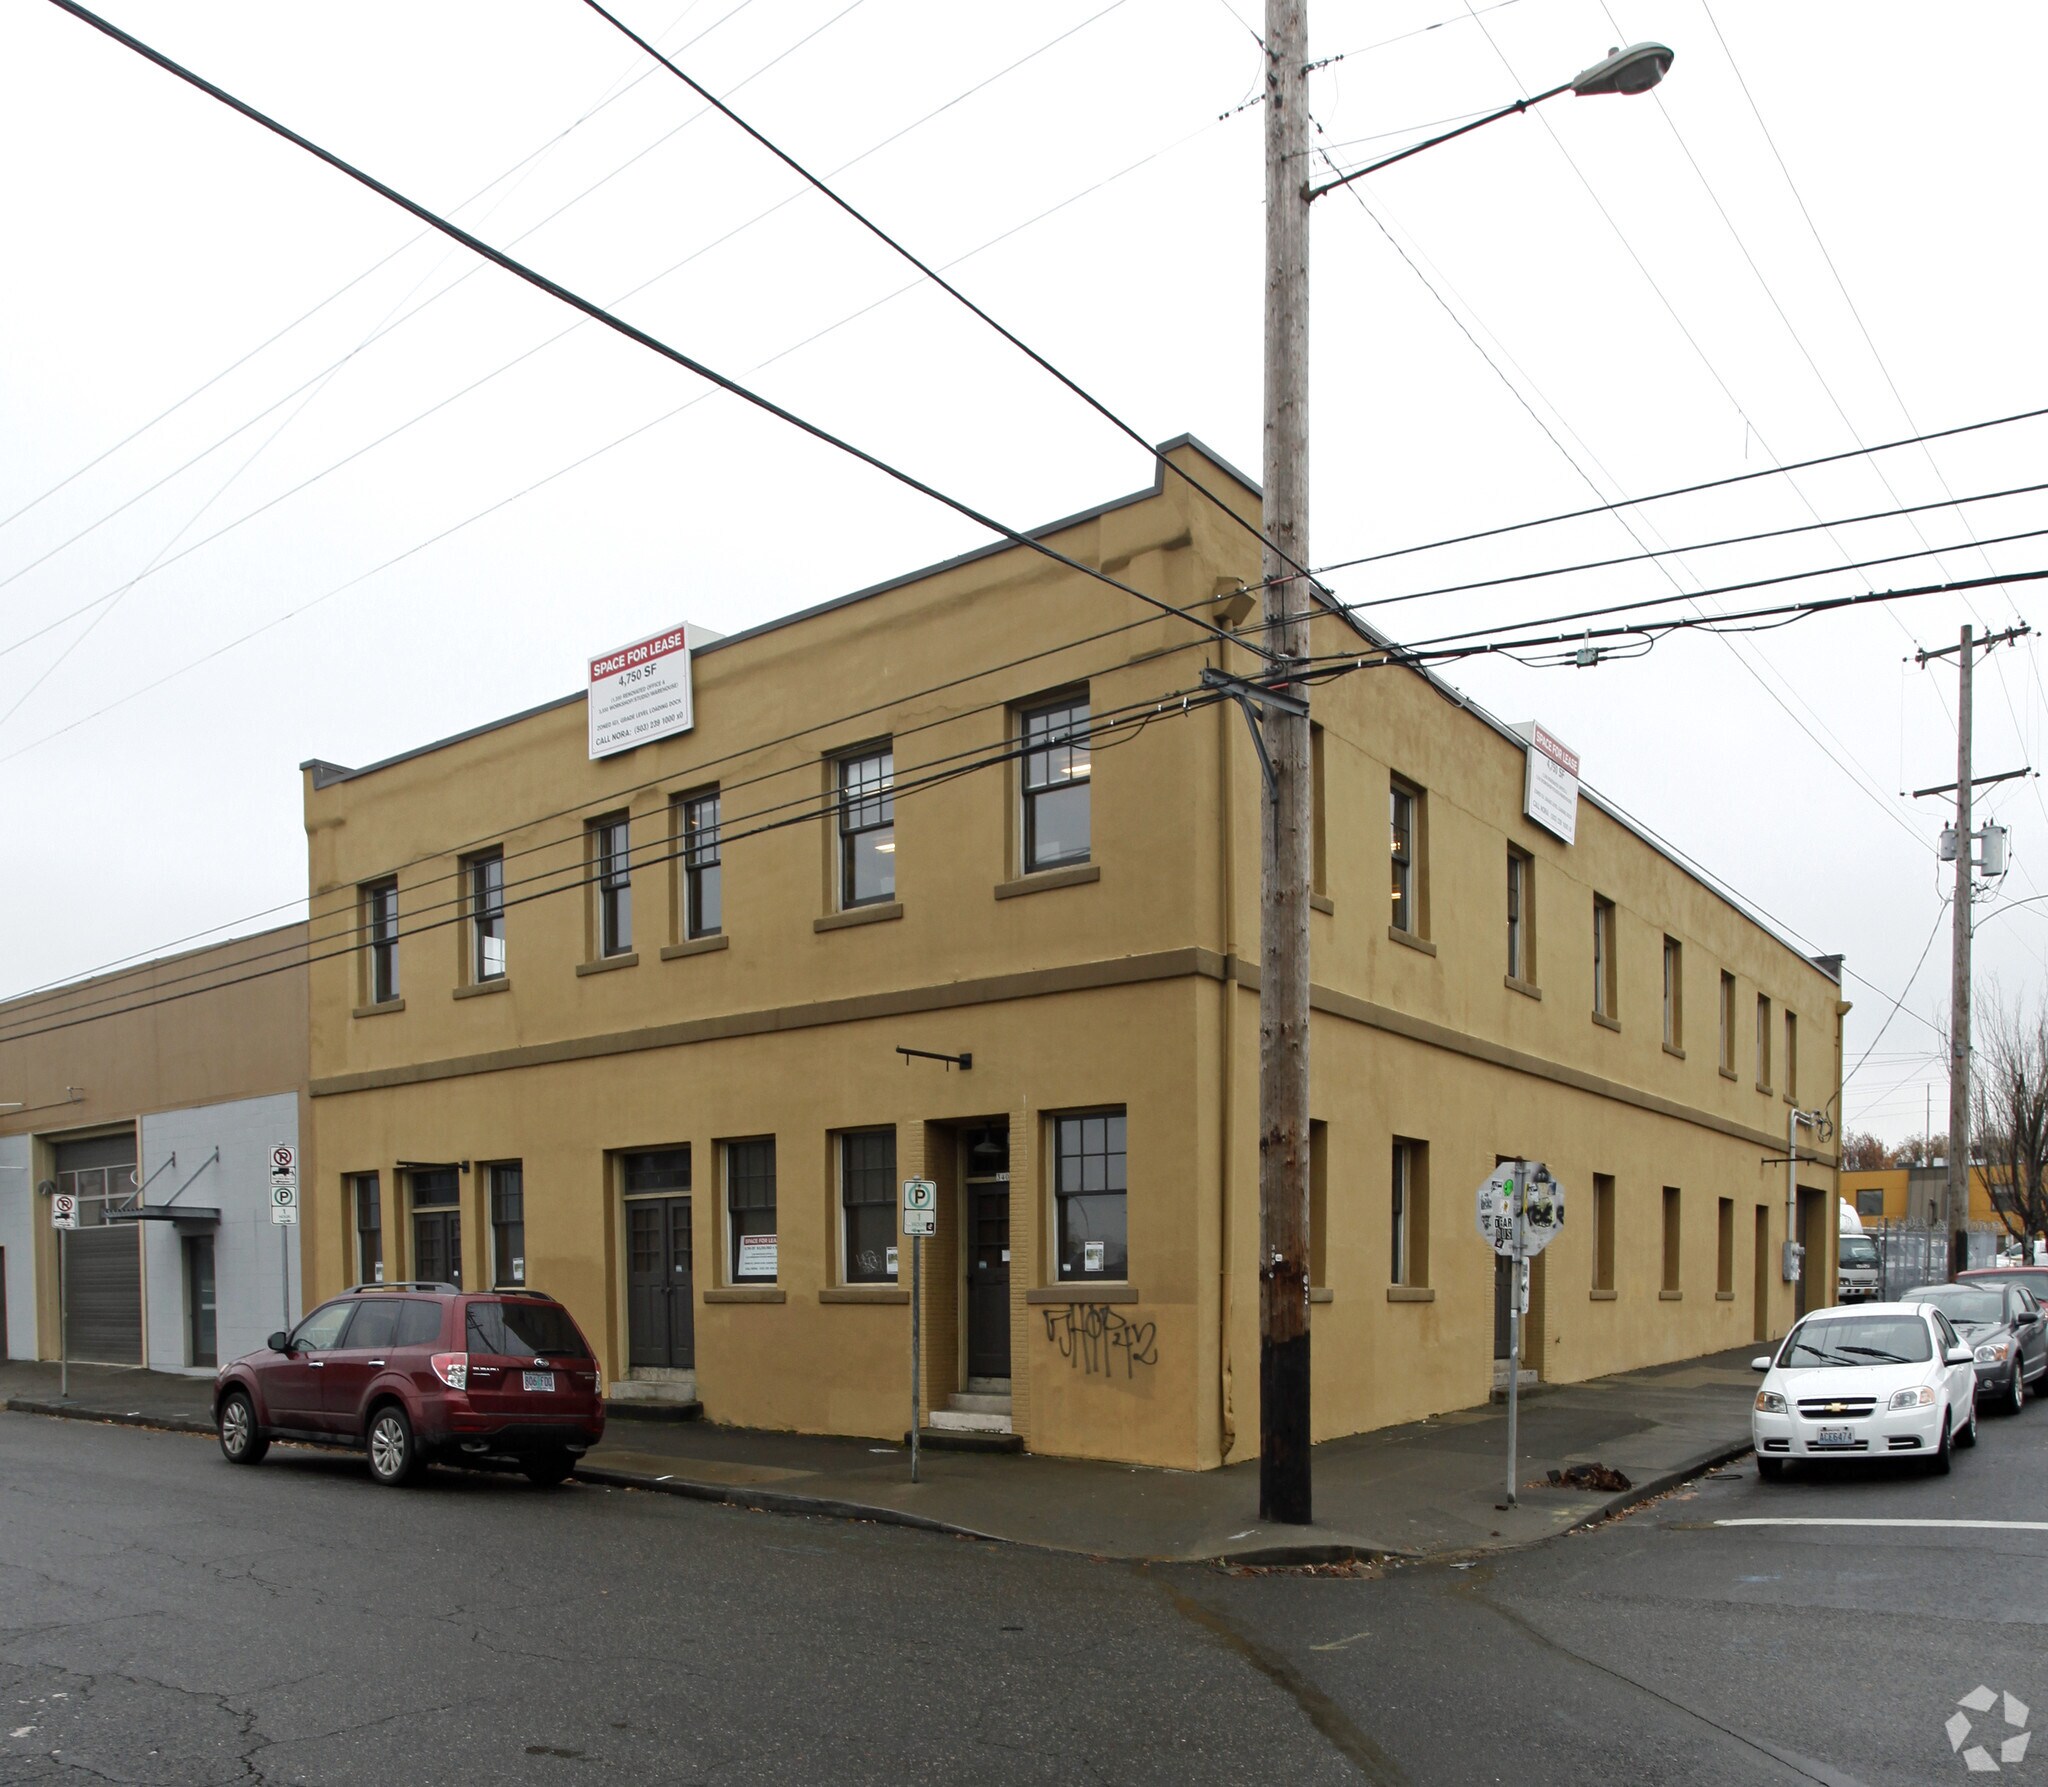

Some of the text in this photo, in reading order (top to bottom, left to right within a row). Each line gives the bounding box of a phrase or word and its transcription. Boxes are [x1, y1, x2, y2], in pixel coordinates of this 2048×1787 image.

[593, 632, 682, 676] SPACE FOR LEASE
[618, 663, 657, 687] 4,750 SF
[595, 736, 610, 746] CALL
[611, 729, 632, 741] NORA:
[1536, 731, 1578, 772] SPACE FOR LEASE
[280, 1191, 288, 1201] P
[914, 1189, 926, 1204] P
